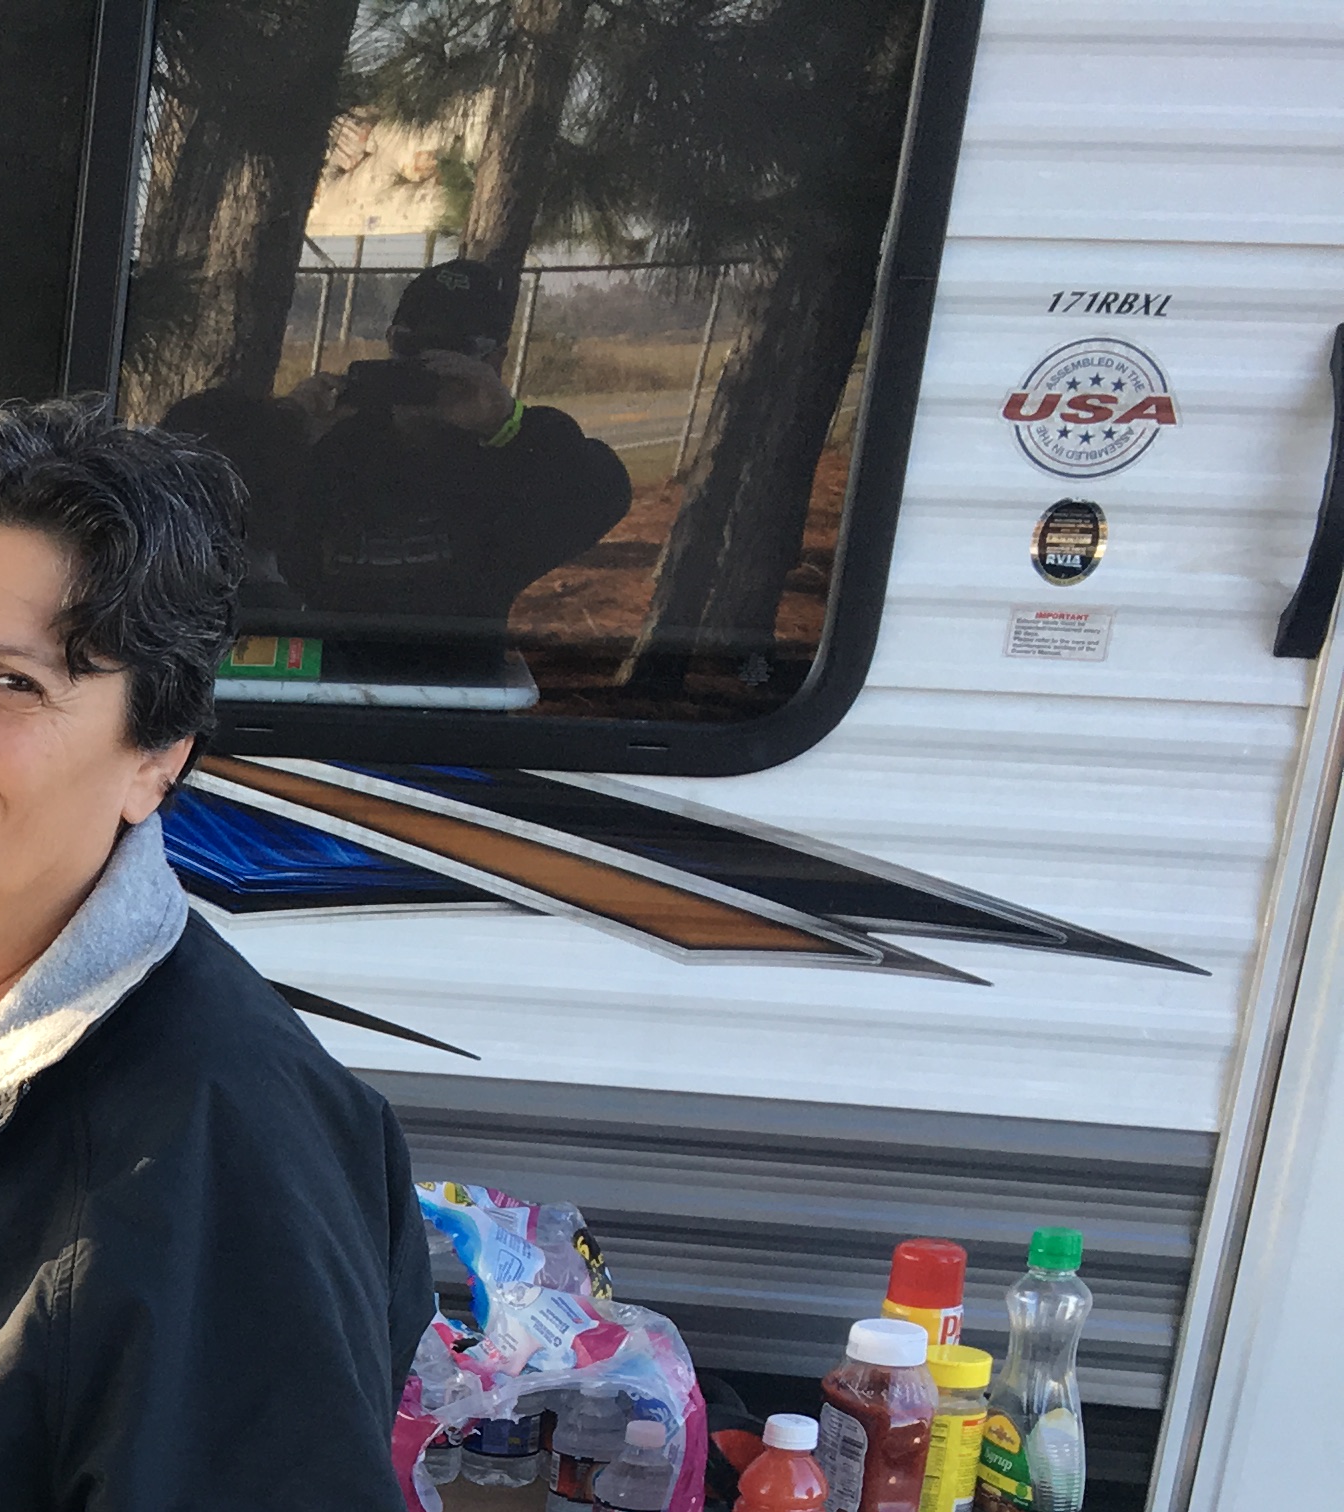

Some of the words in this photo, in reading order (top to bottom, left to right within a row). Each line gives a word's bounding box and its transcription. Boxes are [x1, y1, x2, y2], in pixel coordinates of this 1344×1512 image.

[1047, 291, 1173, 317] 171RBXL
[1045, 356, 1115, 391] ASSEMBLED
[1114, 361, 1130, 375] IN
[1127, 370, 1146, 393] THE
[1002, 392, 1178, 425] USA
[1035, 611, 1089, 621] IMPORTANT
